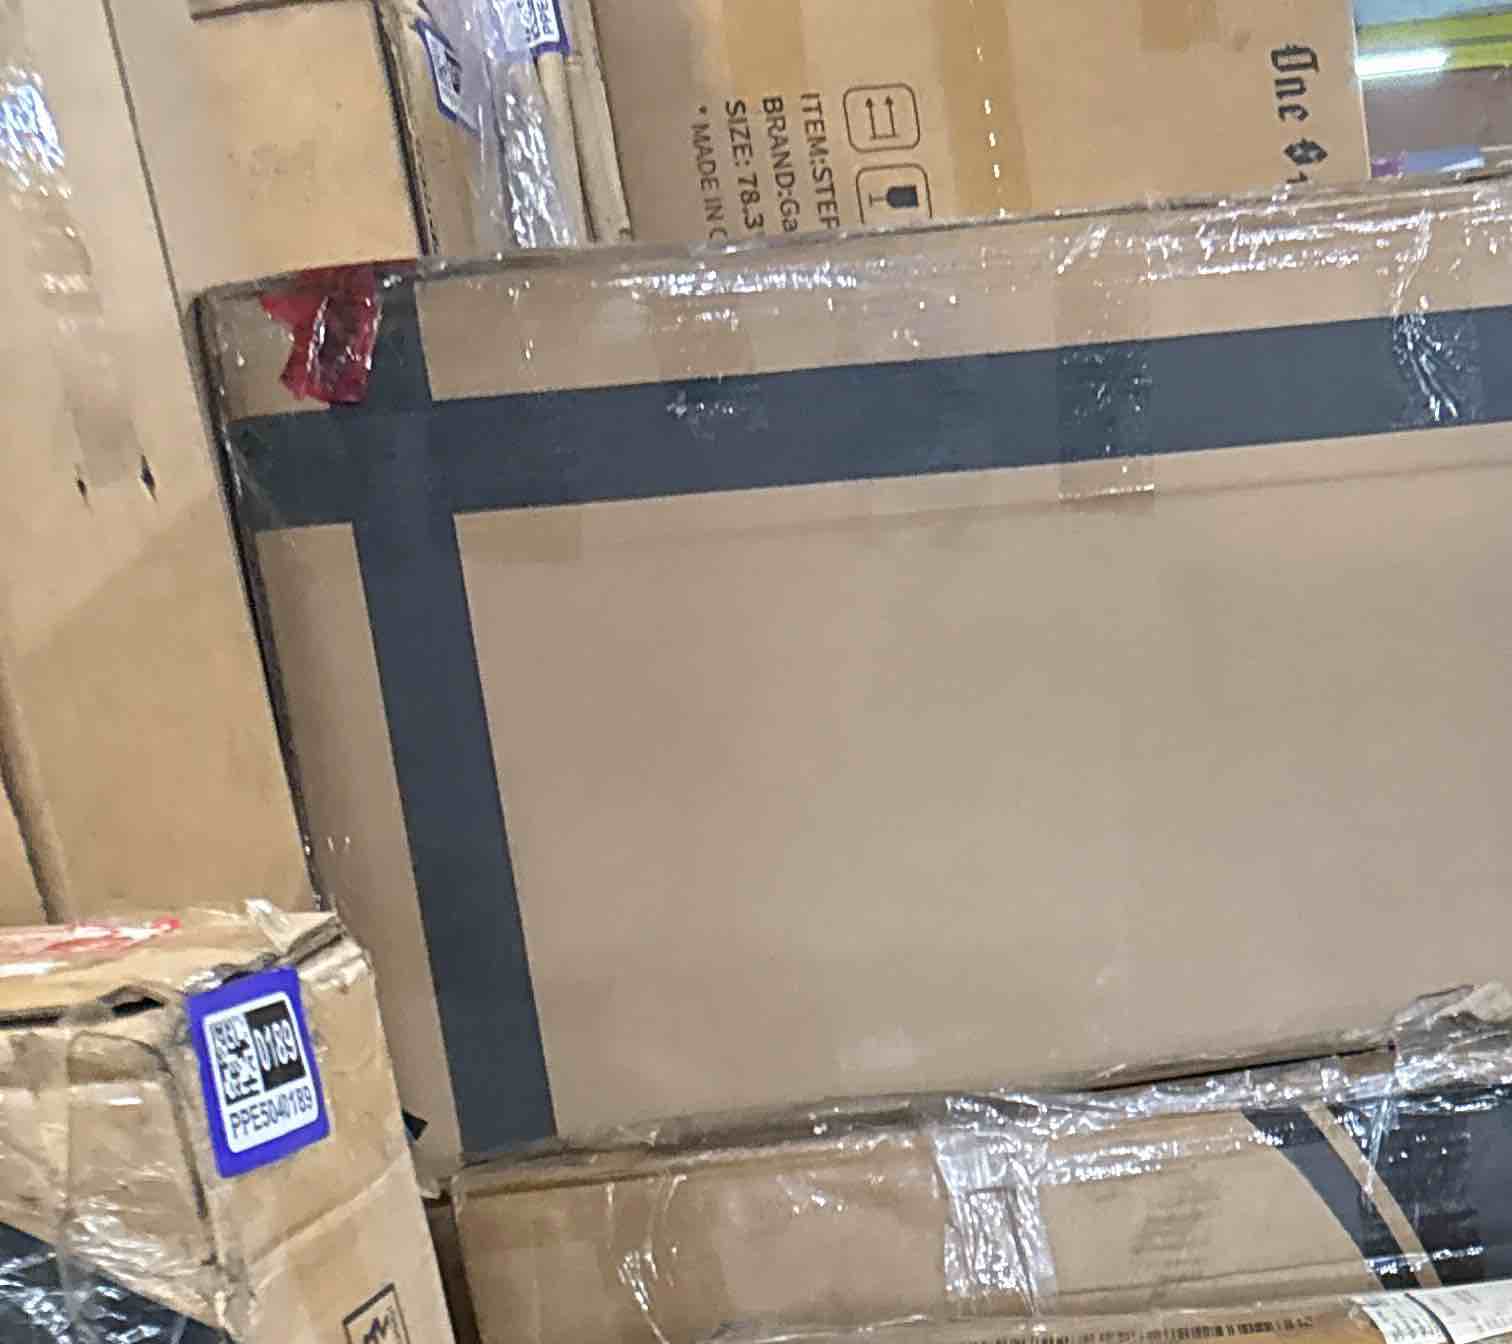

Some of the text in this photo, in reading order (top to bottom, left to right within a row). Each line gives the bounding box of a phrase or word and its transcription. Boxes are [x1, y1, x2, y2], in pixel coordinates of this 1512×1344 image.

[691, 123, 720, 192] MADE
[724, 99, 755, 168] SIZE:
[705, 197, 725, 223] IN
[252, 1017, 299, 1073] 0189
[228, 1095, 314, 1140] PPE5040189
